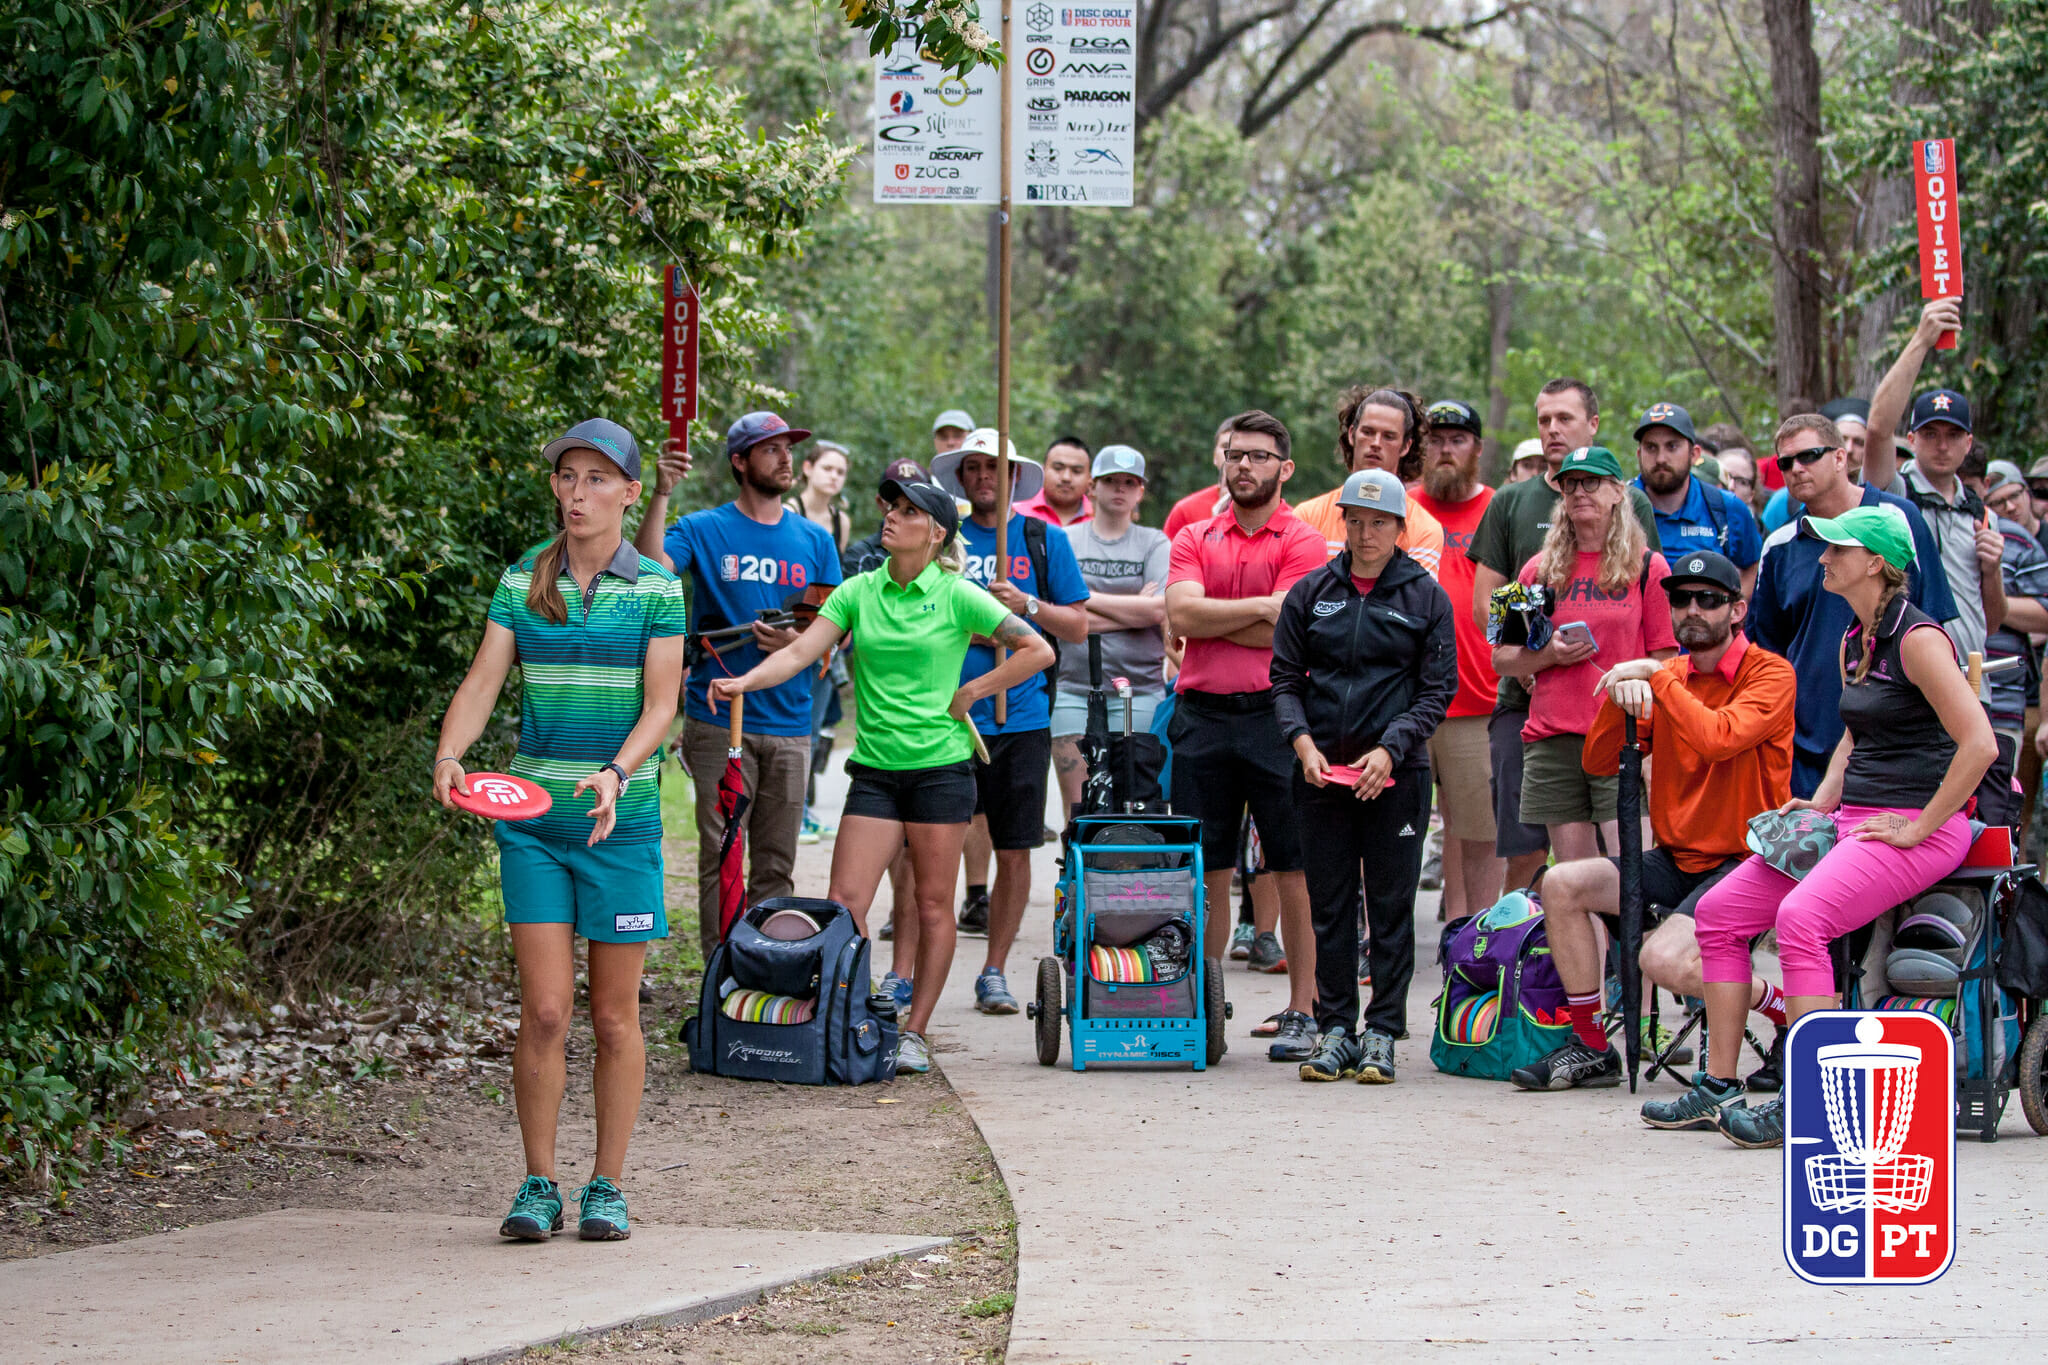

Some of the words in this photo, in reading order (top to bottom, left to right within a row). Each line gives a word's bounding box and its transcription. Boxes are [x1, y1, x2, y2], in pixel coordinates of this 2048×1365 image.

[1075, 9, 1100, 18] DISC
[1103, 9, 1131, 18] GOLF
[1075, 18, 1097, 27] PRO
[1100, 18, 1131, 27] TOUR
[1071, 38, 1130, 48] DGA
[1027, 79, 1055, 87] GRIP6
[1065, 91, 1131, 102] PARAGON
[929, 151, 983, 160] DISCRAFT
[1045, 184, 1088, 200] PDGA
[1928, 176, 1950, 294] QUIET
[672, 301, 689, 418] QUIET
[740, 555, 806, 588] 2018
[742, 1049, 793, 1058] PRODIGY
